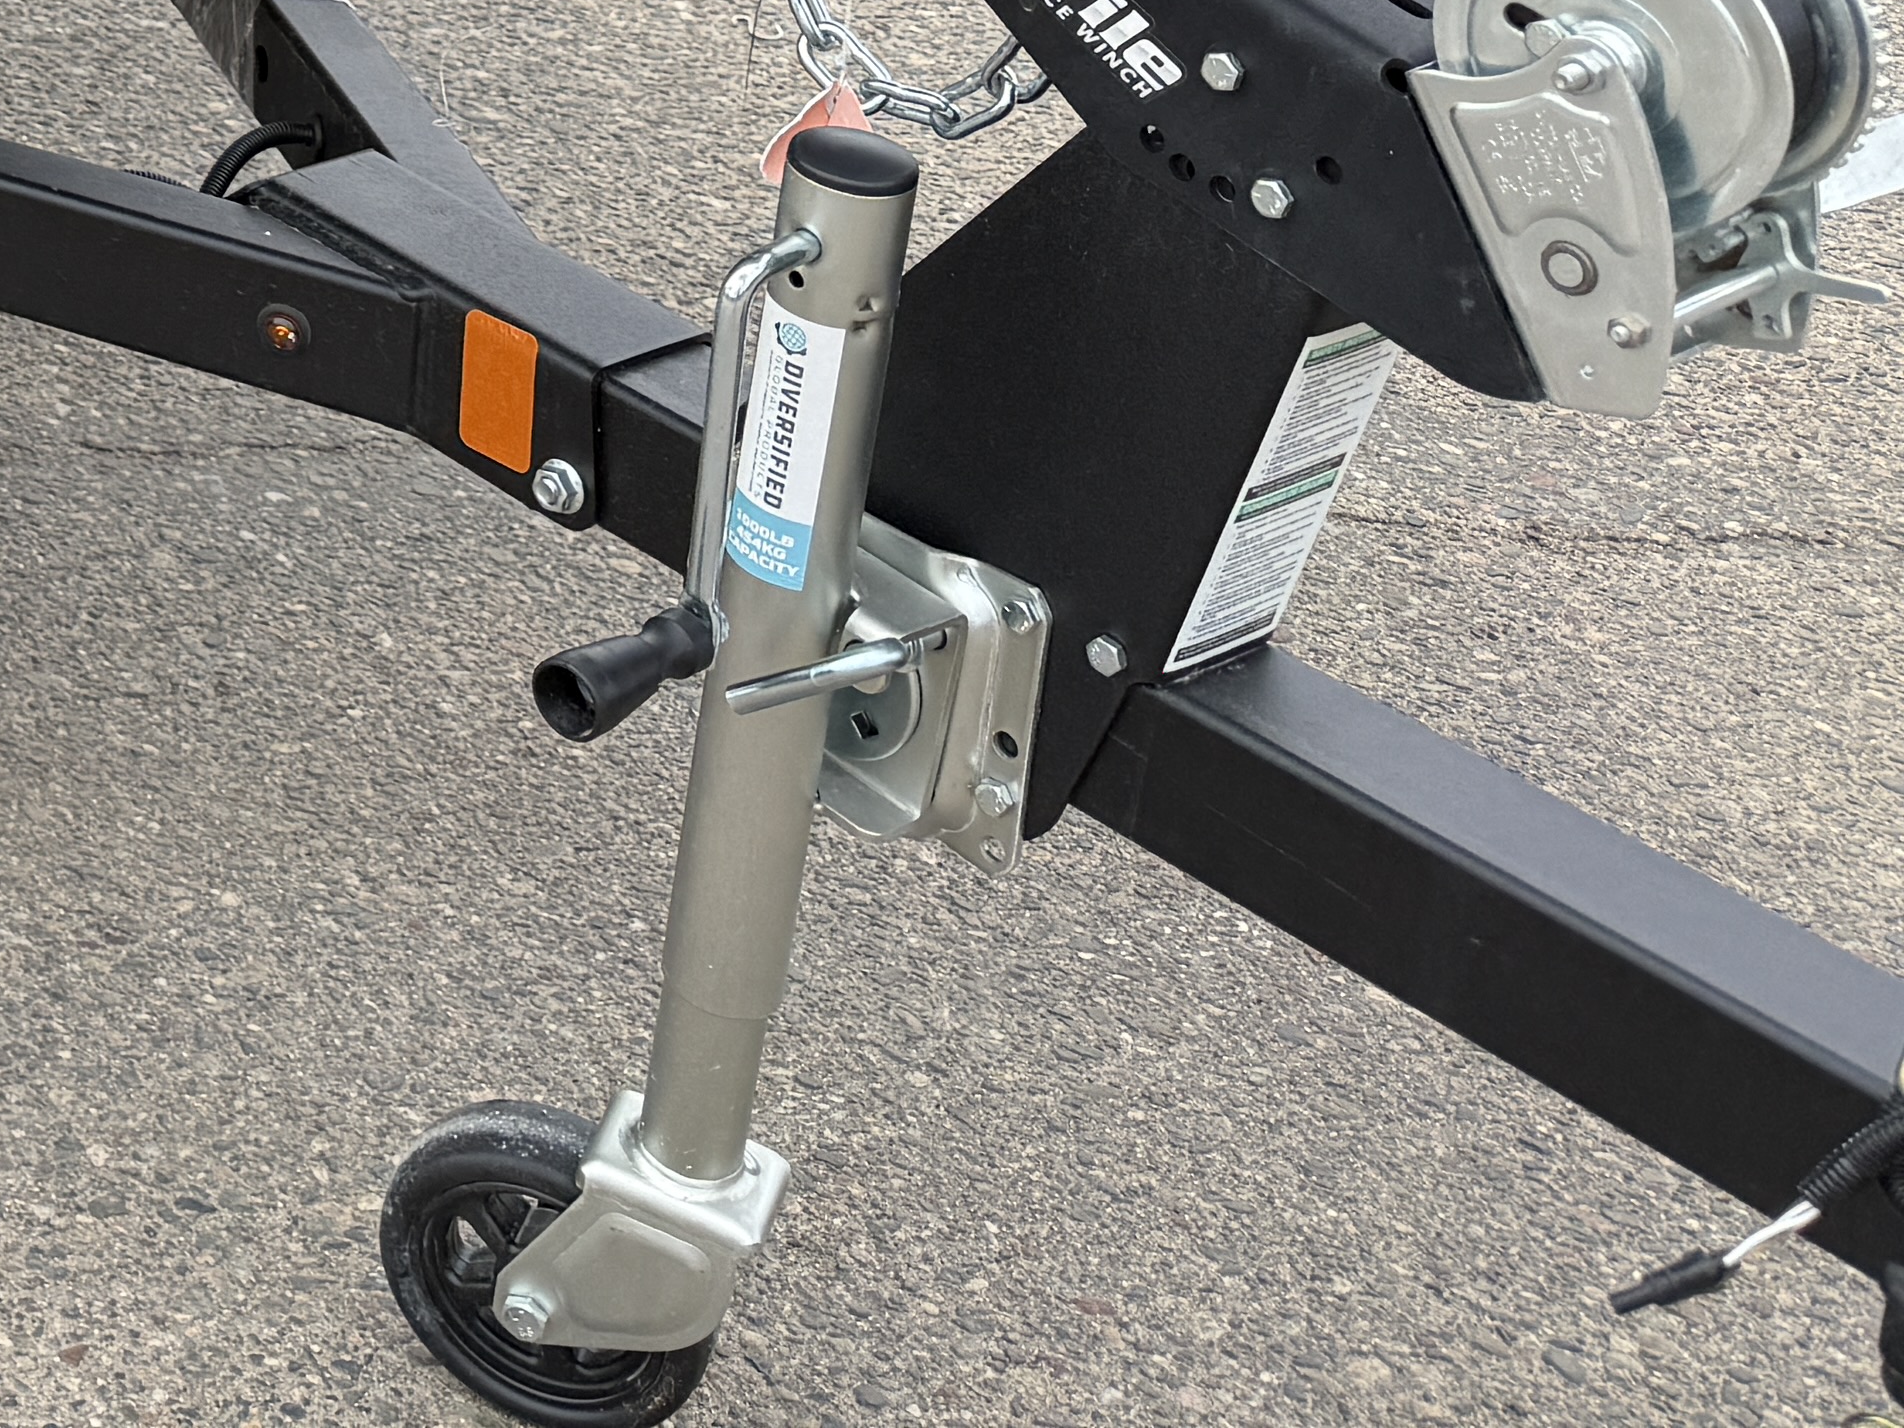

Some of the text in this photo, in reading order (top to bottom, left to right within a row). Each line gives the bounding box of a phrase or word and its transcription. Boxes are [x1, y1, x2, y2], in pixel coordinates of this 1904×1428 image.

[1075, 22, 1153, 100] WINCH
[763, 359, 805, 510] DIVERSIFIED
[735, 506, 796, 549] 1000LB
[737, 525, 788, 561] 454KG
[727, 529, 801, 578] CAPACITY
